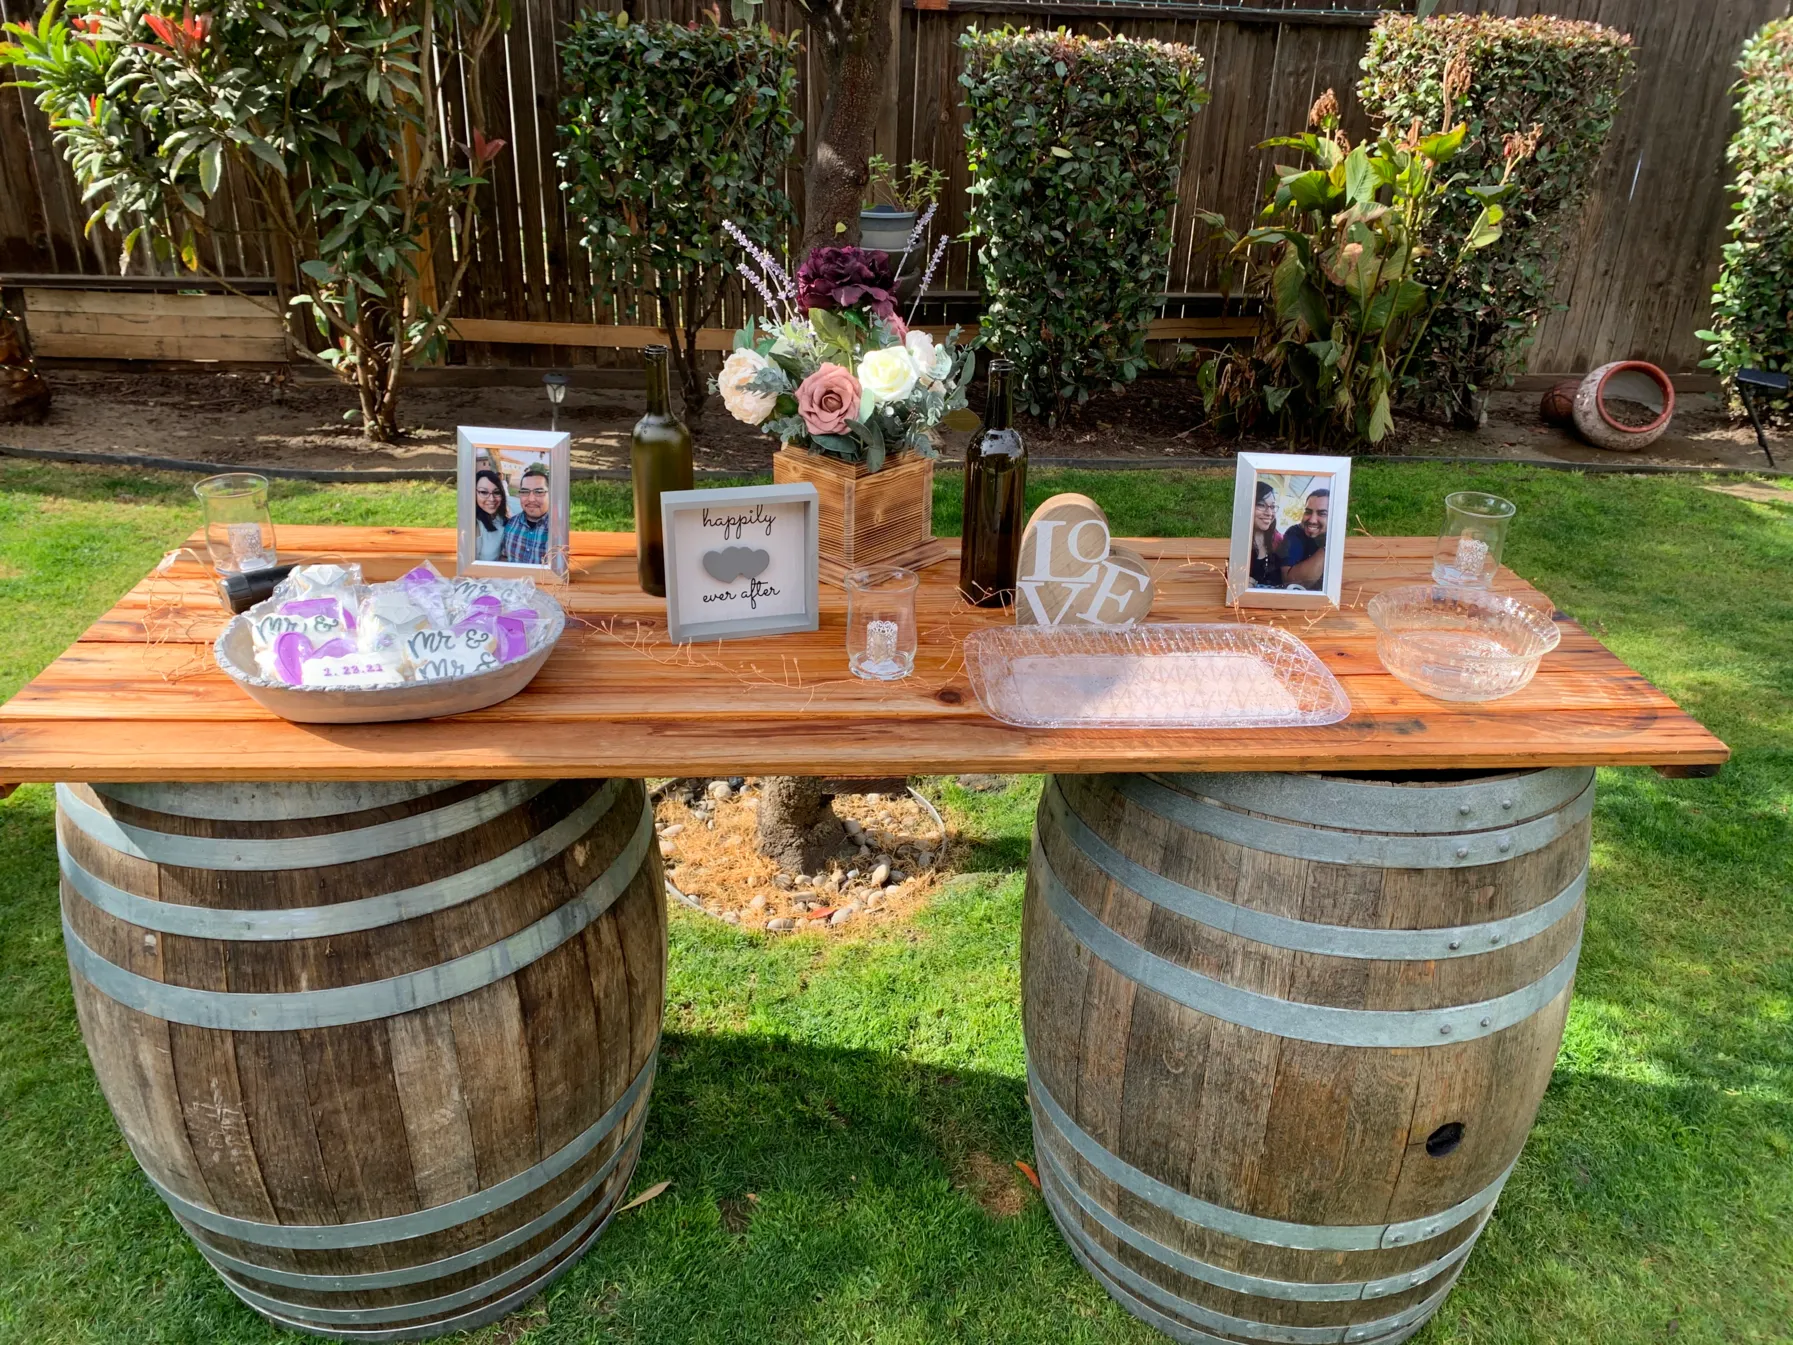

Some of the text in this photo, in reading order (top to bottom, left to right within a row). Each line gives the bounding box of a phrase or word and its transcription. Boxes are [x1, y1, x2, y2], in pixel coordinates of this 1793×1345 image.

[702, 504, 776, 540] happily
[702, 578, 780, 609] ever after
[407, 628, 489, 659] Mr &
